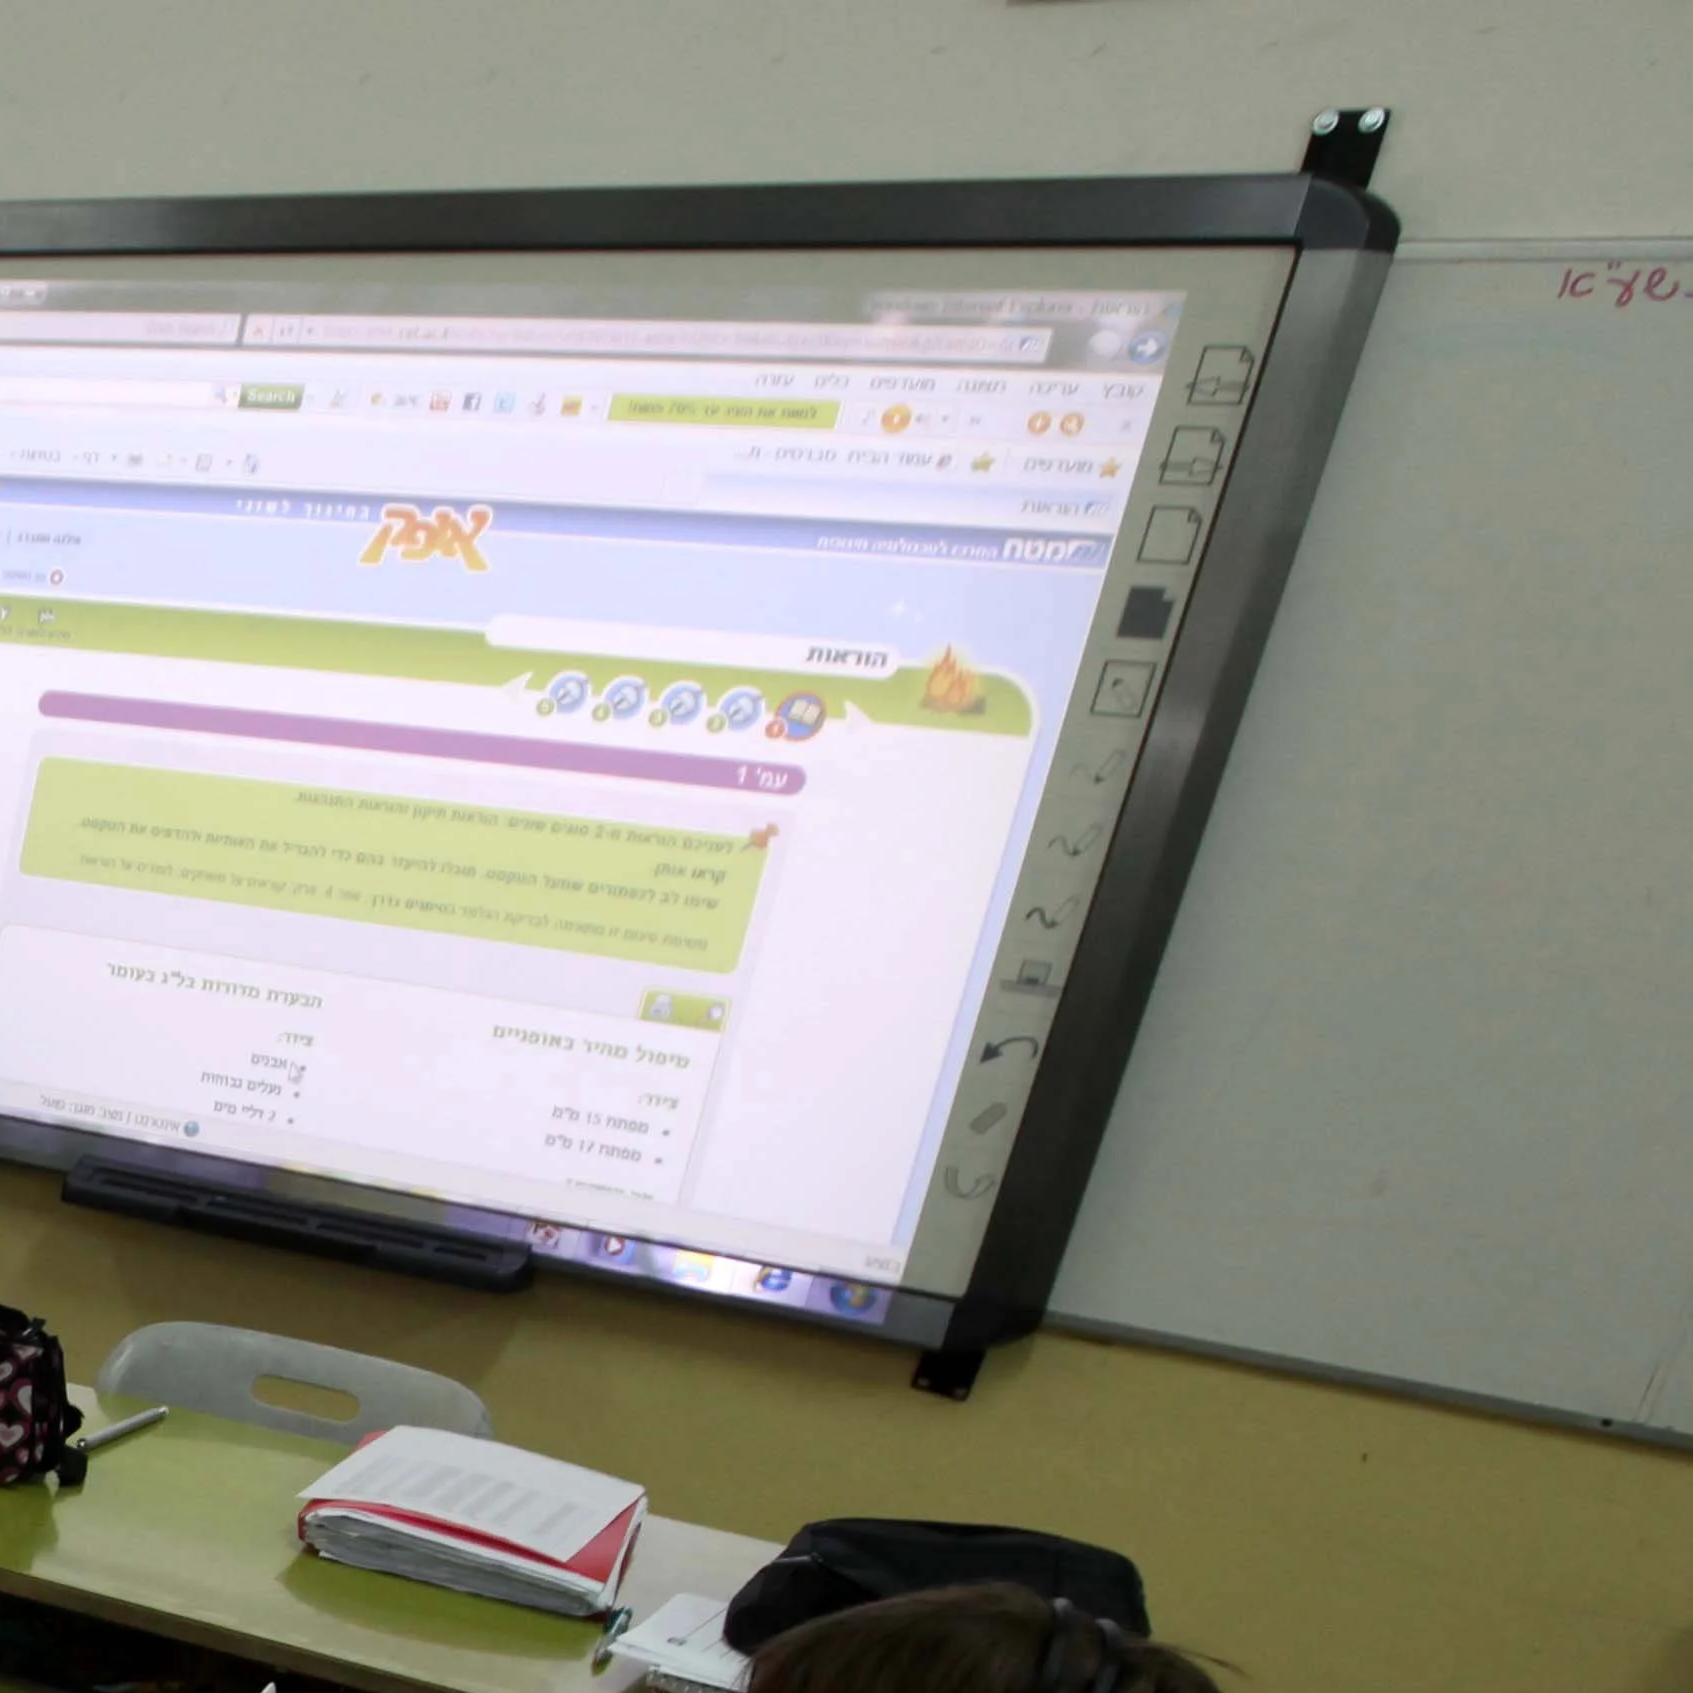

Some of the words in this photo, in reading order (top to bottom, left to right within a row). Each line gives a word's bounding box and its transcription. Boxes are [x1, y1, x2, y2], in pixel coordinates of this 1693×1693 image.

[246, 388, 296, 405] Search
[804, 645, 890, 669] הוראות
[107, 962, 156, 983] בעומר
[200, 978, 261, 1000] מדורות
[492, 1023, 576, 1051] באופניים
[581, 1037, 629, 1060] מהיר
[606, 1114, 650, 1135] מפתח
[598, 1141, 643, 1164] מפתח
